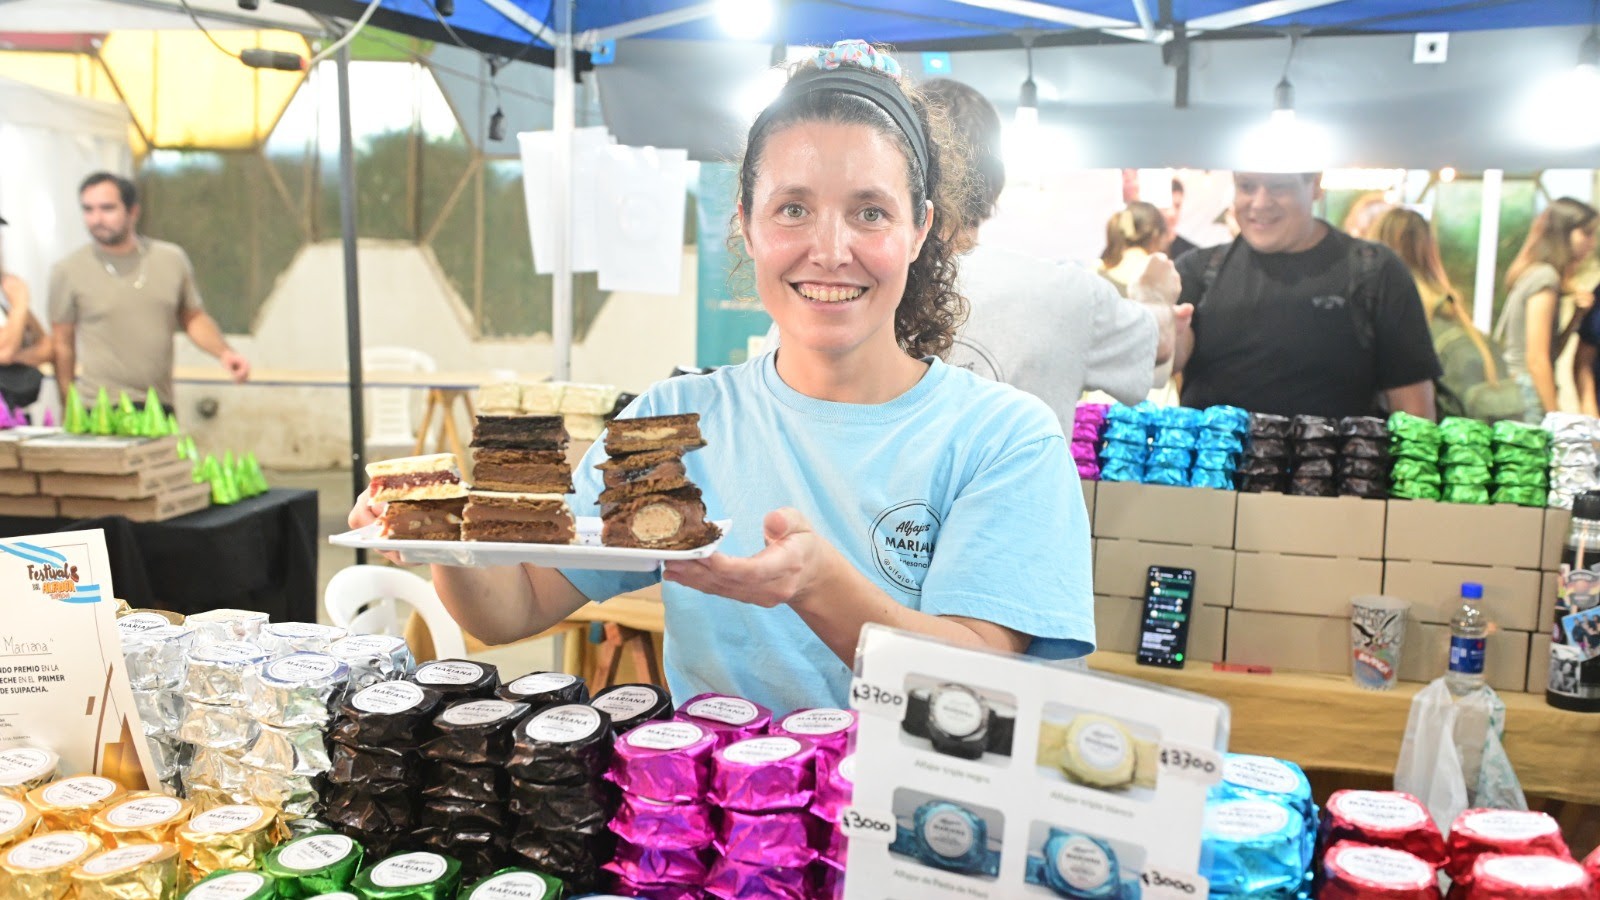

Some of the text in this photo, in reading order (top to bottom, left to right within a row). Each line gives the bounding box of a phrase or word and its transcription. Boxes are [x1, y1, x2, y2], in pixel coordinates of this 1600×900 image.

[27, 562, 70, 581] Festival
[13, 665, 40, 673] PREMIO
[41, 664, 50, 672] EN
[51, 664, 60, 672] LA
[286, 660, 326, 672] MARIANA
[433, 665, 473, 677] MARIANA
[18, 676, 28, 684] EN
[28, 675, 35, 683] EL
[37, 674, 65, 682] PRIMER
[10, 685, 49, 694] SUIPACHA.
[372, 687, 413, 702] MARIANA
[607, 695, 647, 704] MARIANA
[463, 705, 503, 713] MARIANA
[702, 702, 748, 716] MARIANA
[544, 714, 588, 727] MARIANA
[796, 714, 844, 722] MARIANA
[127, 804, 167, 816] MARIANA
[208, 812, 249, 822] MARIANA
[389, 861, 433, 875] MARIANA
[487, 884, 533, 899] MARIANA
